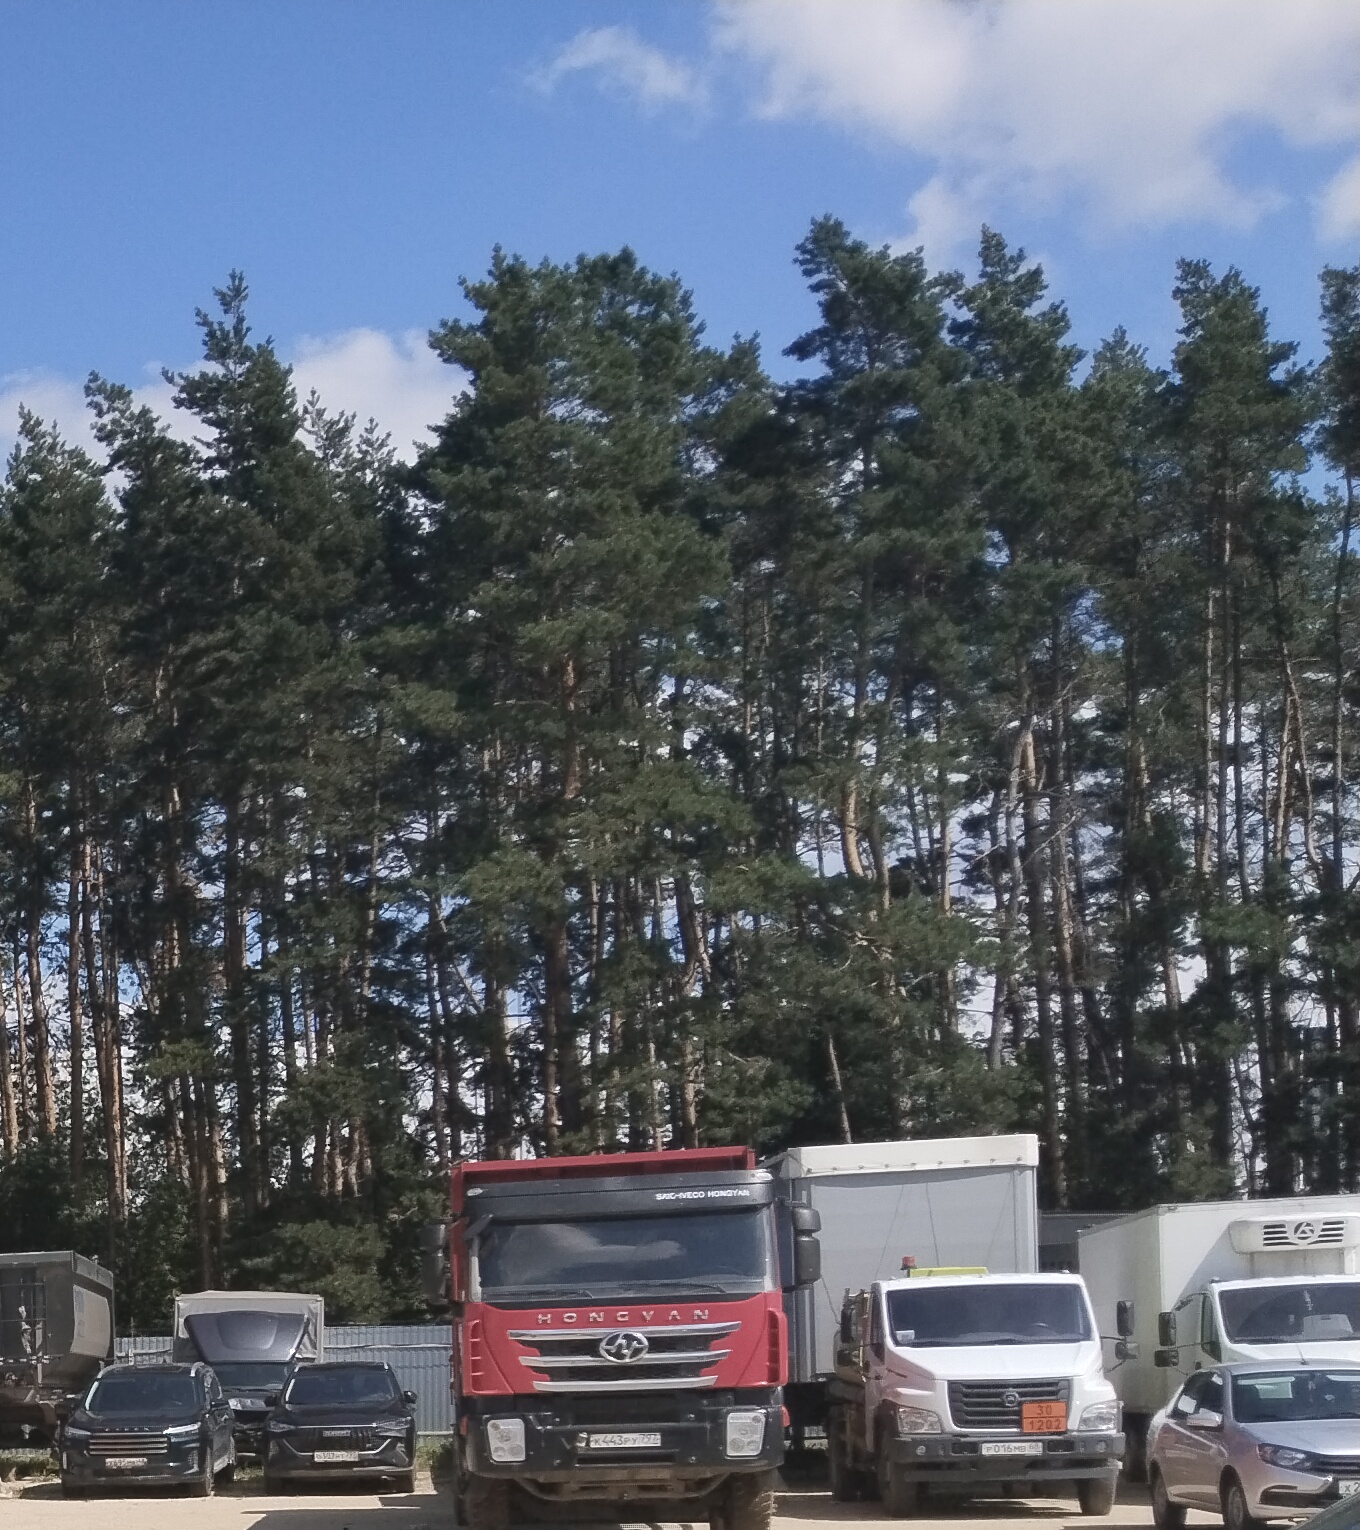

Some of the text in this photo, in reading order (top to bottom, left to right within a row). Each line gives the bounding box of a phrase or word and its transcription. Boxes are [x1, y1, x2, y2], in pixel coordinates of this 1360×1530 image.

[537, 1309, 709, 1324] HONGYAN
[1037, 1404, 1053, 1416] 30
[1029, 1418, 1062, 1431] 1202
